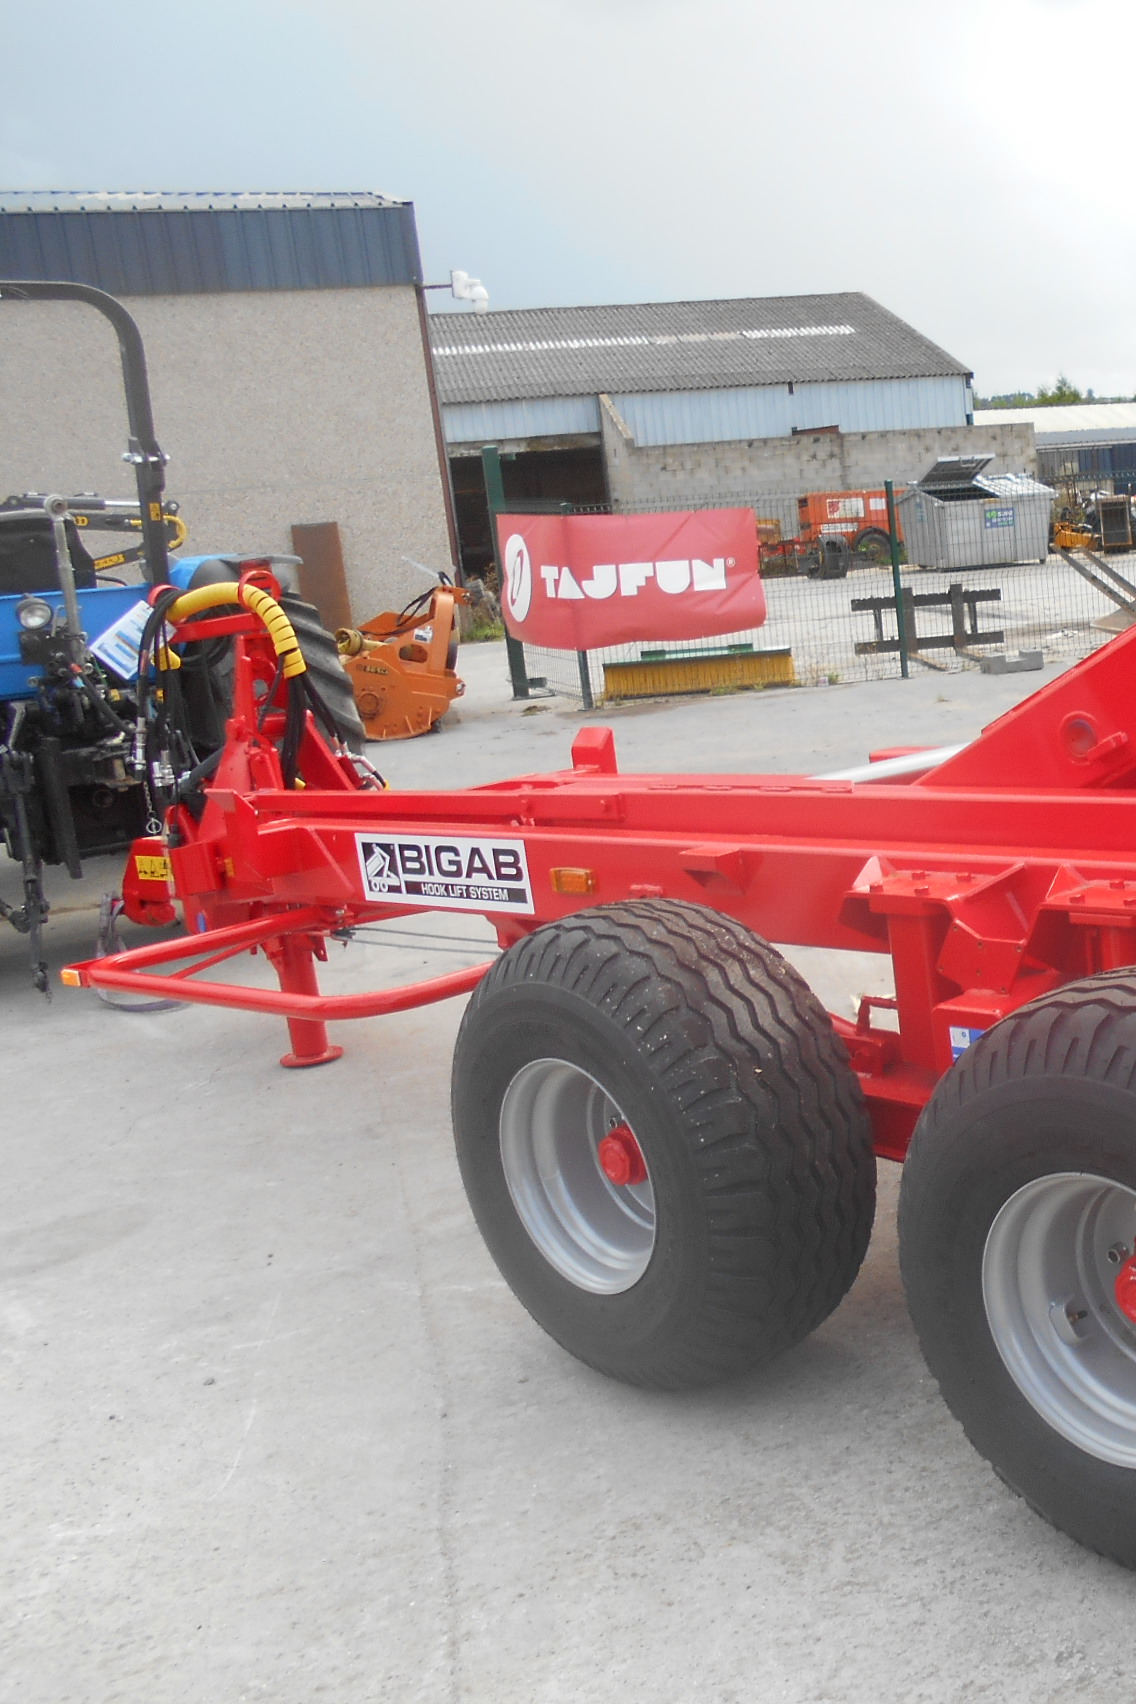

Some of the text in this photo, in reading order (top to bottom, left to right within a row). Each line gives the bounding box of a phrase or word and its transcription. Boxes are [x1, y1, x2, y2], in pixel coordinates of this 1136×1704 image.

[540, 558, 727, 600] TAJFUN
[398, 843, 525, 882] BIGAB
[421, 882, 509, 901] HOOK LIFT SYSTEM
